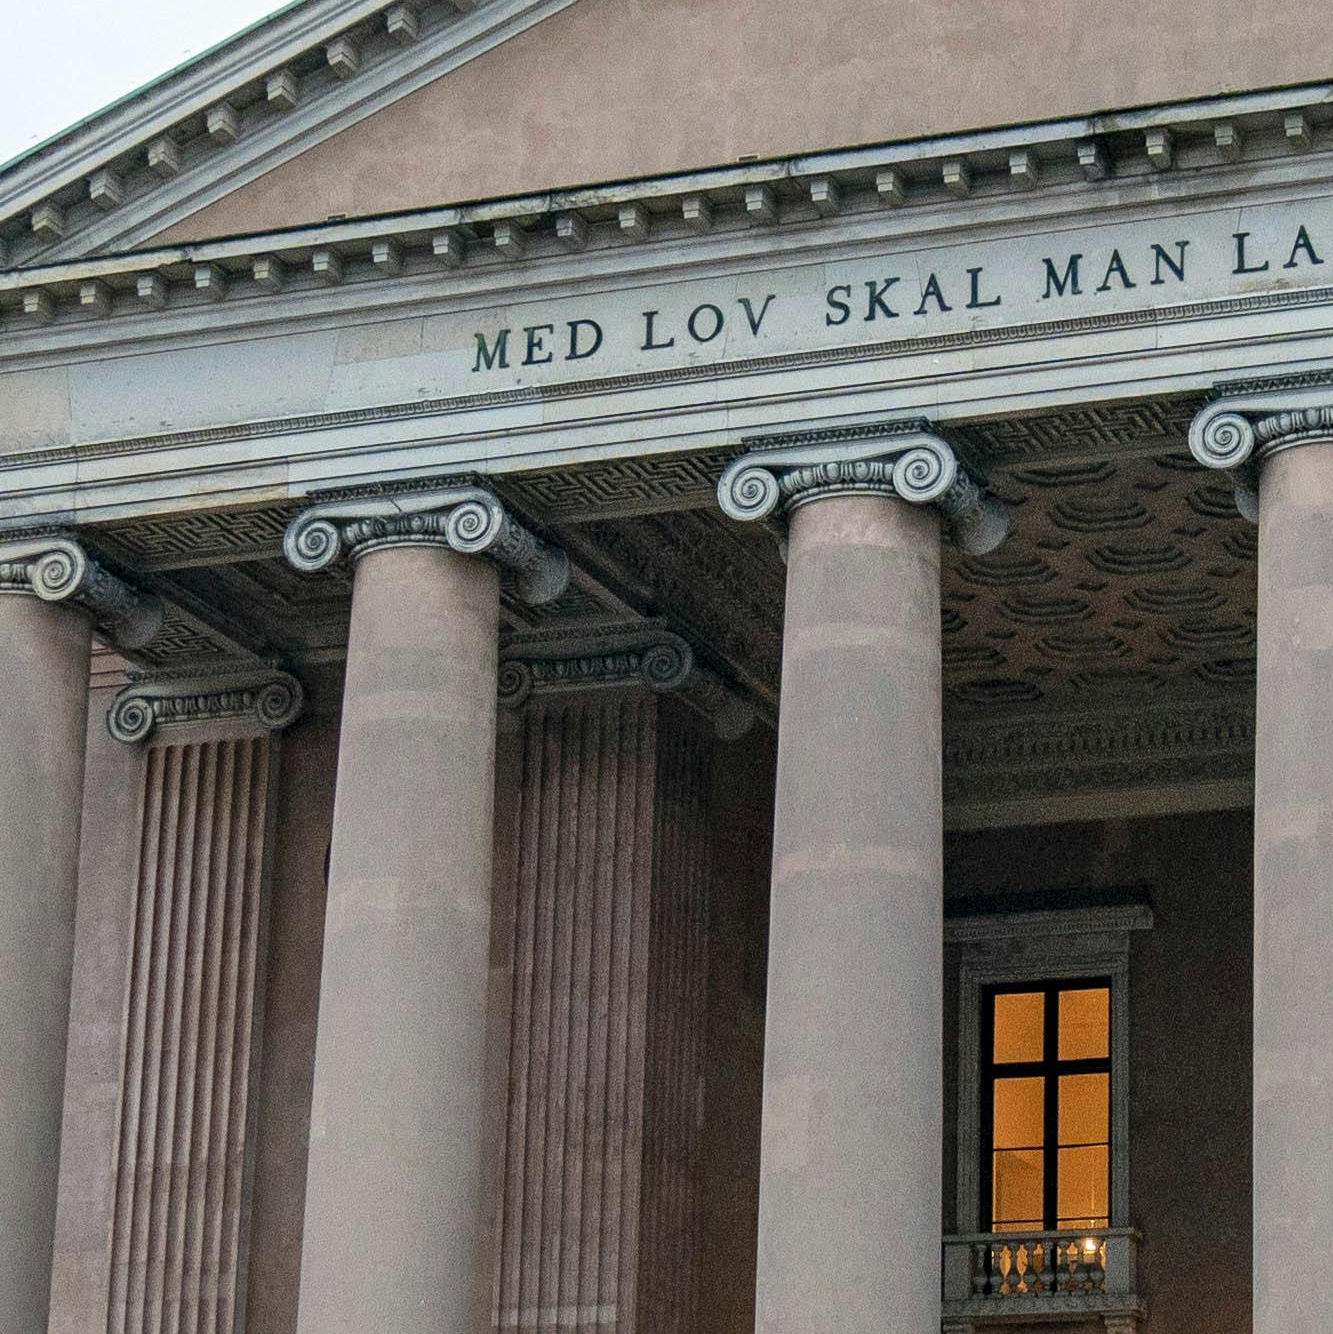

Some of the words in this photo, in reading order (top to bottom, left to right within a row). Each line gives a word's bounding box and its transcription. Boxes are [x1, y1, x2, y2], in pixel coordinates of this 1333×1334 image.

[471, 317, 605, 373] MED
[641, 293, 779, 353] LOV
[823, 275, 1003, 328] SKAL
[1041, 240, 1190, 299] MAN
